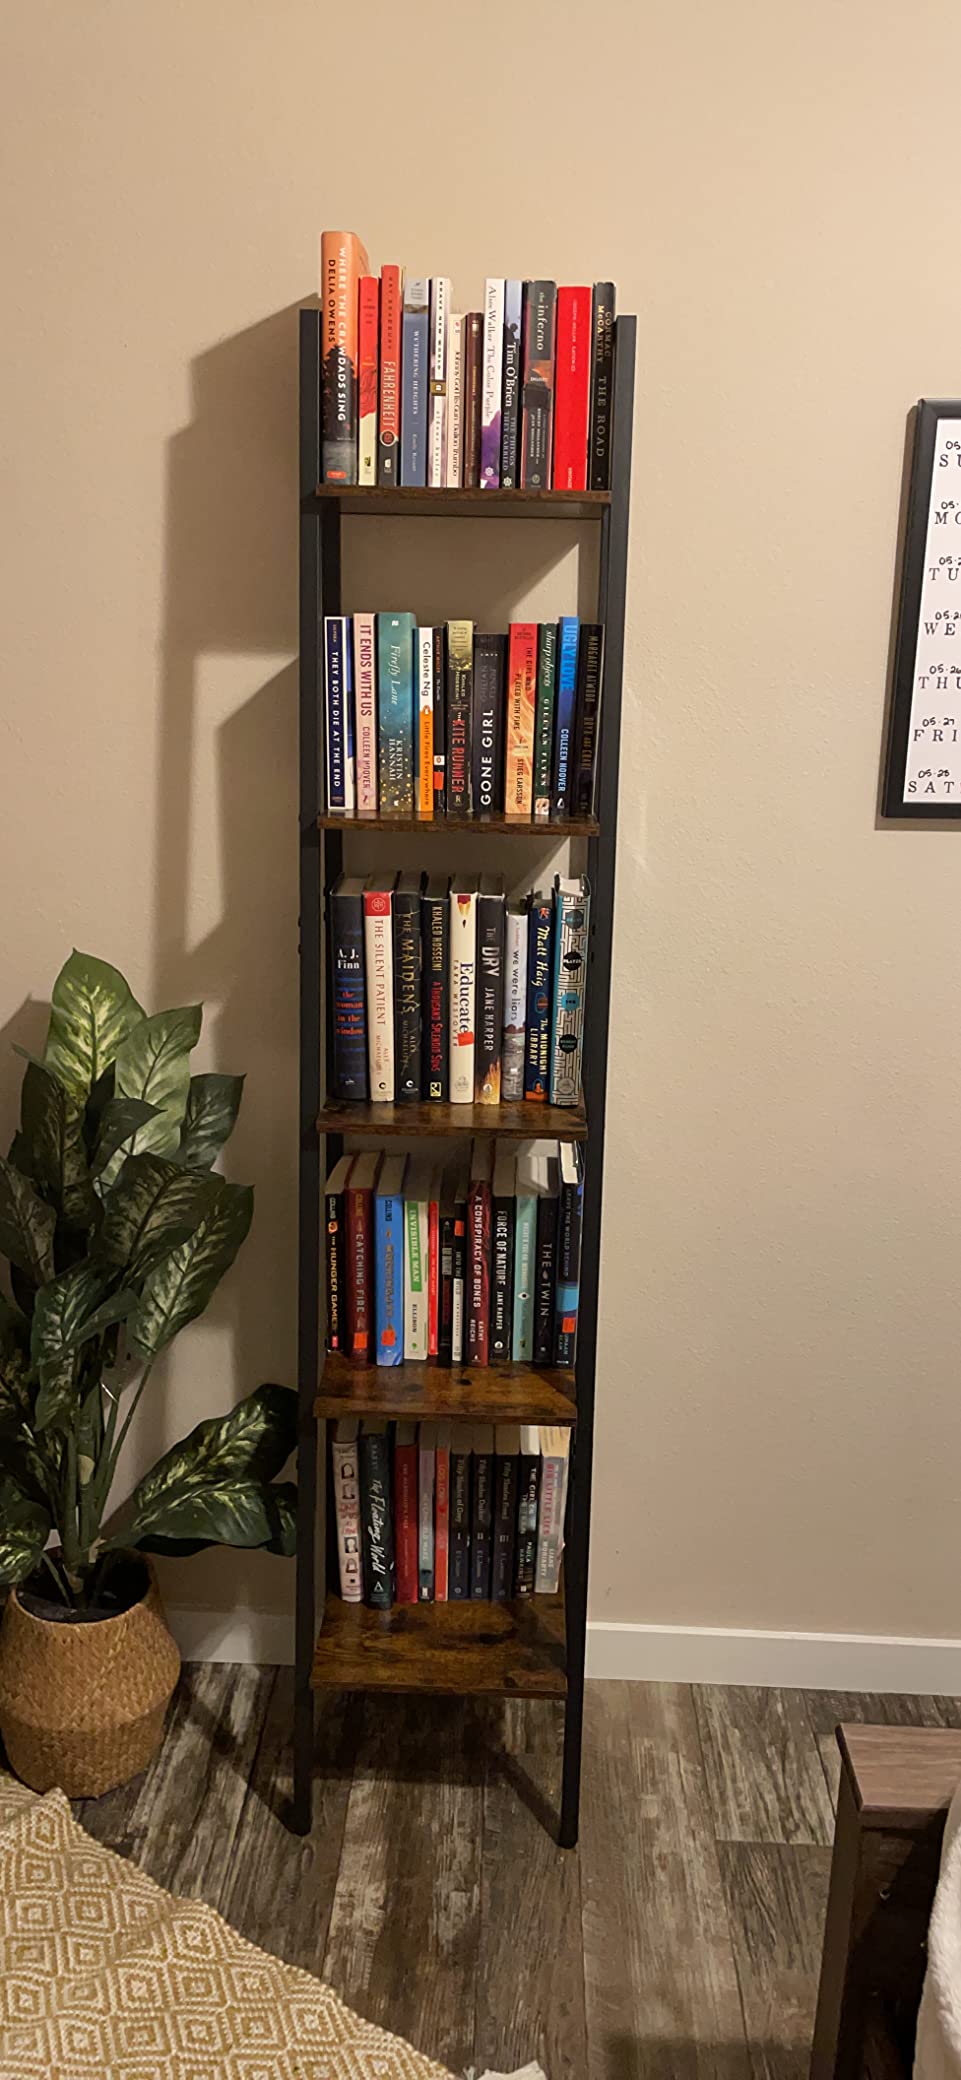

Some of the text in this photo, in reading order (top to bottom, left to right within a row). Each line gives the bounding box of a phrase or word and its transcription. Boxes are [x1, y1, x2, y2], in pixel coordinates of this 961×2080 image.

[328, 259, 336, 342] DELIA OWENS
[487, 286, 497, 308] Alice
[337, 247, 347, 421] WHERE THE CRAWDADS SING
[487, 310, 497, 341] Walker
[536, 304, 549, 351] inferno
[597, 305, 605, 363] McCARTHY
[604, 311, 613, 357] CORMAC
[412, 331, 420, 415] WUTHERING HEIGHTS
[486, 365, 495, 388] Color
[487, 345, 496, 363] The
[506, 342, 517, 364] Tim
[382, 361, 396, 427] FAHRENHEIT
[596, 375, 607, 457] THE ROAD
[508, 435, 516, 466] THINGS
[331, 651, 339, 675] THEY
[360, 625, 372, 716] IT ENDS WITH US
[388, 645, 401, 705] Firefly Lane
[421, 642, 431, 697] Celeste Ng
[542, 630, 555, 687] sharp objects
[560, 624, 578, 691] UGLY LOVE
[585, 636, 599, 703] MARGARET ATWOOD
[333, 730, 340, 742] AT
[452, 719, 465, 744] KITE
[542, 698, 550, 745] GILLIAN
[913, 729, 958, 742] FRI
[362, 726, 371, 789] COLLEEN HOOVER
[388, 738, 396, 780] HANNAH
[452, 747, 465, 793] RUNNER
[480, 710, 493, 806] GONE GIRL
[558, 728, 569, 792] COLLEEN HOOVER
[907, 780, 955, 794] SAT
[401, 913, 415, 1013] THE MAIDENS
[432, 906, 443, 971] KHALED HOSSEINI
[481, 947, 500, 977] DRY
[513, 950, 519, 965] we
[531, 925, 550, 987] Matt Haig
[337, 959, 360, 969] Finn
[374, 919, 385, 1025] THE SILENT PATIENT
[483, 987, 495, 1051] JANE HARPER
[511, 998, 520, 1021] liars
[529, 1028, 538, 1066] LIBRARY
[539, 1018, 548, 1075] The MIDNIGHT
[409, 1209, 419, 1258] INVISIBLE
[474, 1205, 482, 1262] CONSPIRACY
[496, 1210, 507, 1286] FORCE OF NATURE
[356, 1234, 364, 1313] CATCHING FIRE
[473, 1278, 481, 1308] BONES
[474, 1264, 481, 1276] OF
[540, 1243, 552, 1316] THE TWIN
[367, 1495, 385, 1544] Floating
[544, 1482, 552, 1513] LITTLE
[370, 1544, 386, 1575] World
